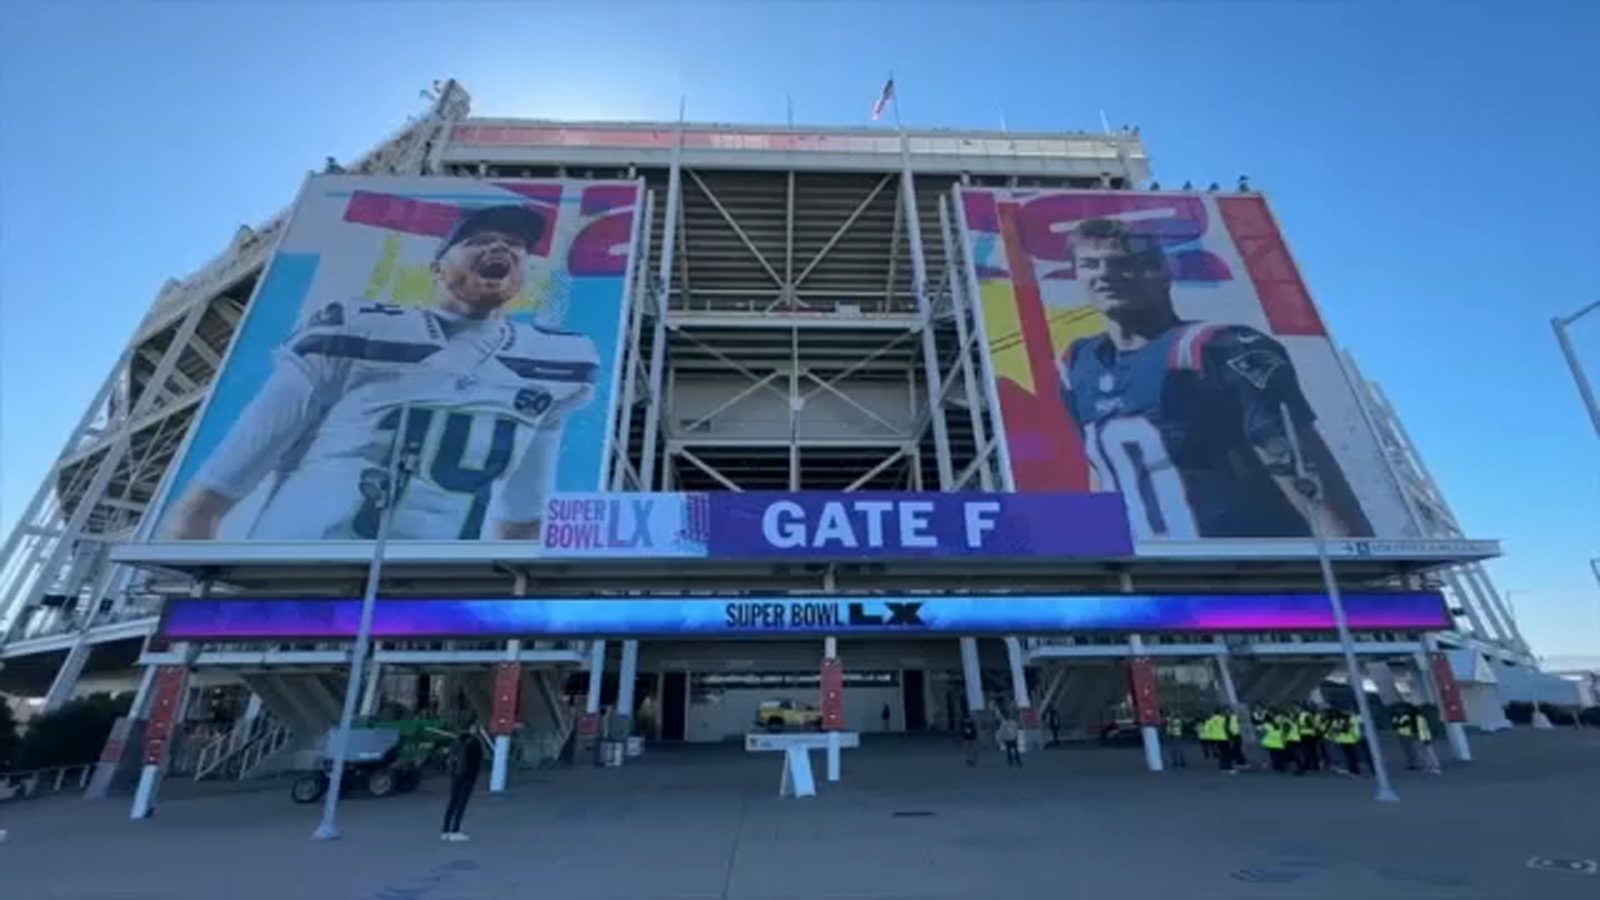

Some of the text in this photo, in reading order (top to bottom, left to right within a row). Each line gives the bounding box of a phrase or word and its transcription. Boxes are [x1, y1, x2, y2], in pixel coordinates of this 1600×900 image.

[548, 499, 605, 521] SUPER
[546, 523, 605, 549] BOWL
[606, 499, 655, 548] LX
[762, 501, 1000, 547] GATE F
[725, 602, 922, 627] SUPER BOWL LX
